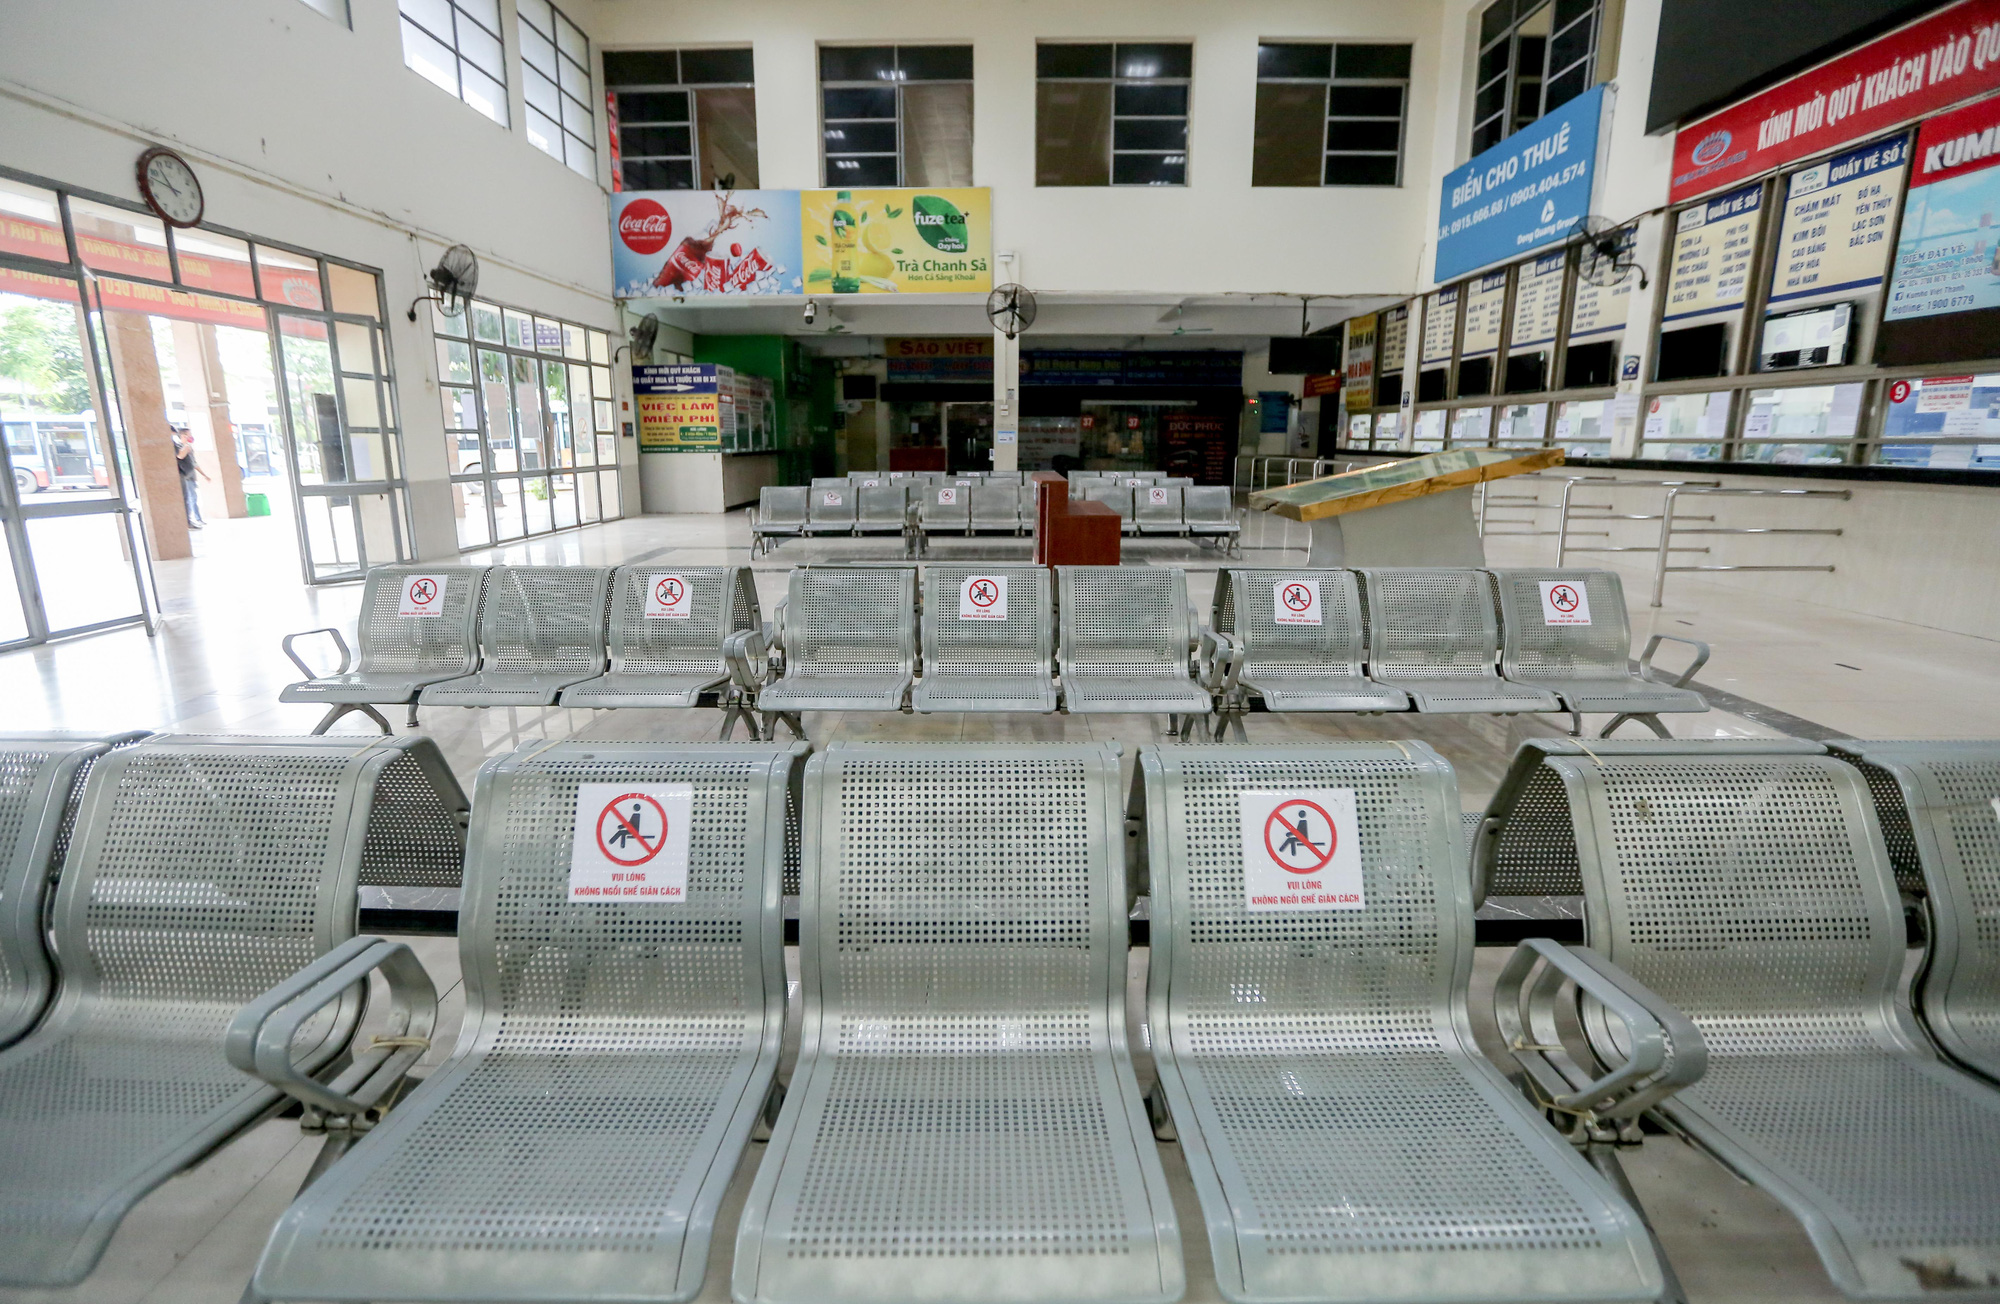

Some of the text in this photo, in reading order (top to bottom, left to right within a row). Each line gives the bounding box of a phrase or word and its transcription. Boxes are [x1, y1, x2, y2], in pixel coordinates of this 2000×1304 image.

[1757, 109, 1794, 151] KÍNH
[1794, 90, 1826, 137] MỜI
[1827, 74, 1861, 127] QUÝ
[1862, 57, 1926, 111] KHÁCH
[1929, 34, 1971, 85] VÀO
[1881, 142, 1901, 165] SỐ
[1452, 122, 1571, 208] BIỂN CHO THUÊ
[1510, 160, 1586, 208] 0903.404.574
[620, 214, 668, 233] Coca-Cola
[1792, 229, 1809, 243] KIM
[897, 258, 987, 271] Trà Chanh Sả
[1927, 298, 1949, 310] 1900
[1951, 295, 1974, 306] 6779
[900, 341, 940, 355] SAO
[1894, 382, 1905, 400] 9
[642, 402, 676, 412] VIỆC
[689, 414, 715, 422] PHÍ
[1083, 417, 1093, 427] 37
[1128, 417, 1139, 427] 37
[1170, 420, 1192, 431] ĐỨC
[612, 873, 623, 881] VUI
[574, 886, 600, 895] KHÔNG
[603, 885, 620, 895] NGỒI
[623, 885, 638, 895] GHẾ
[660, 885, 680, 895] CÁCH
[1287, 880, 1322, 890] VUI LÒNG
[1252, 895, 1278, 905] KHÔNG
[1281, 893, 1299, 904] NGỒI
[1301, 893, 1316, 904] GHẾ
[1339, 893, 1359, 903] CÁCH
